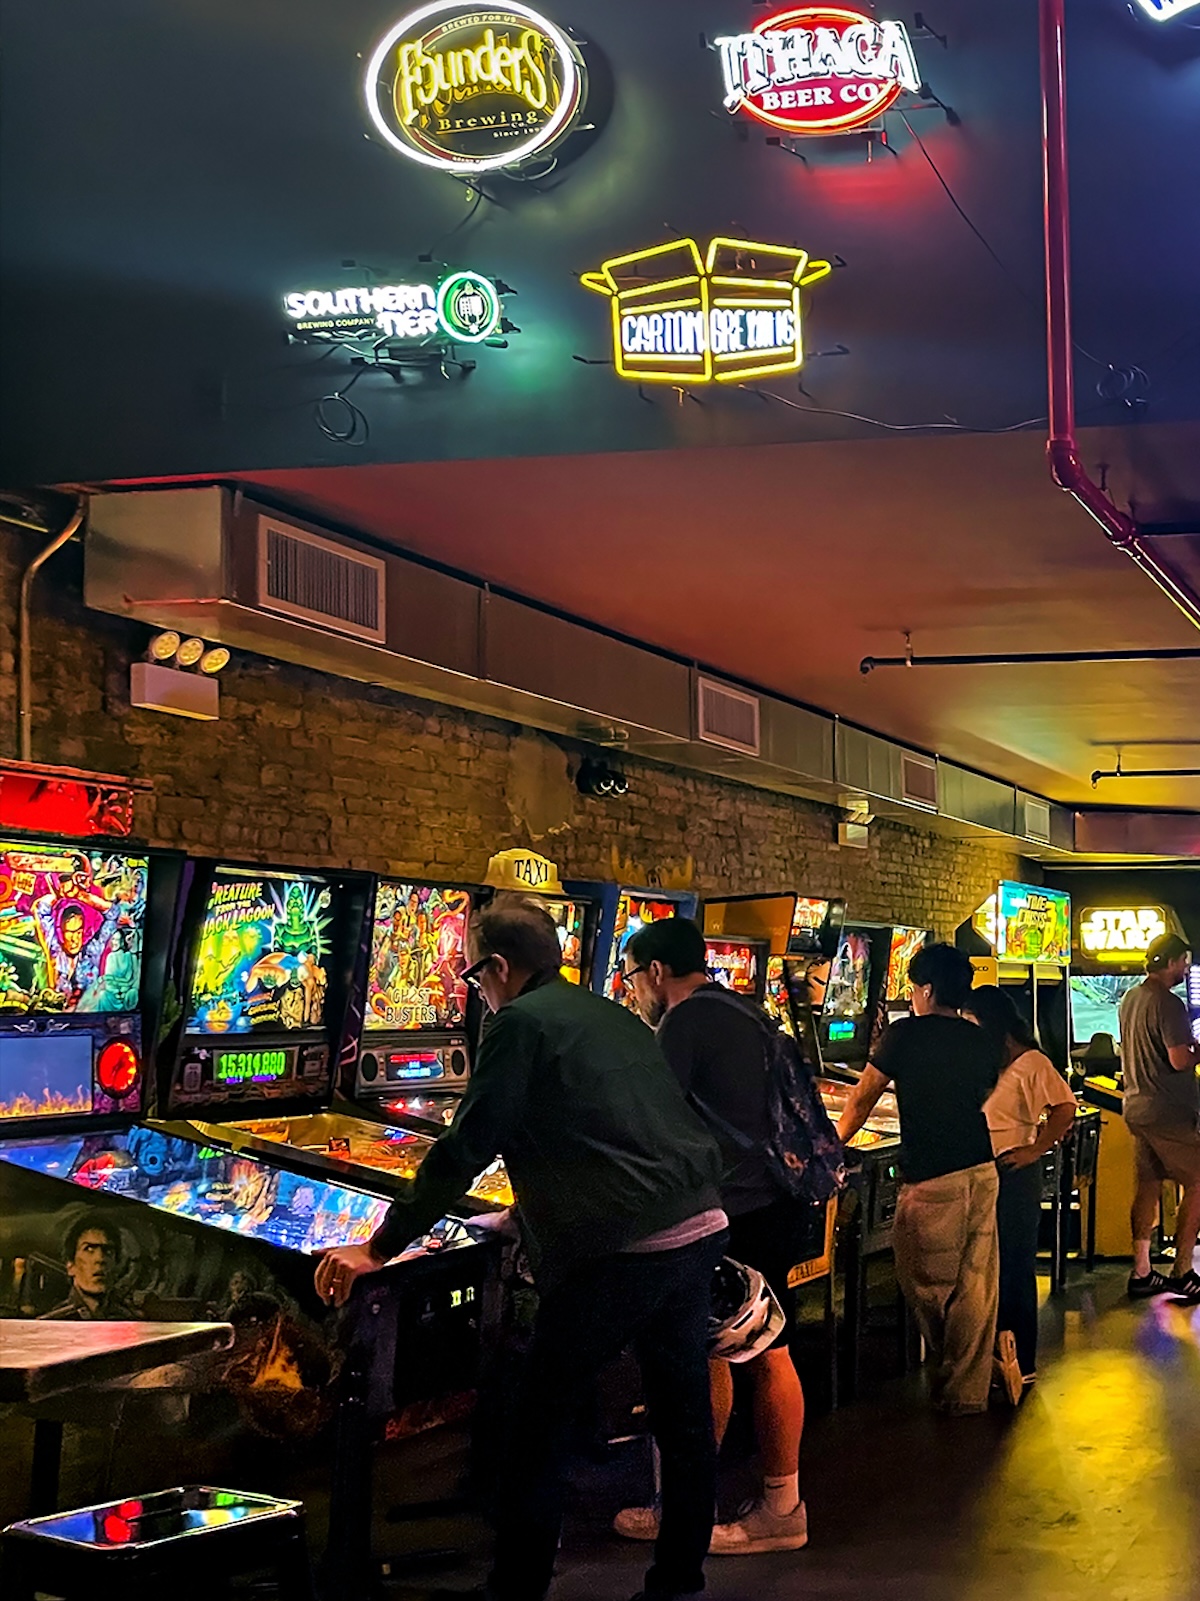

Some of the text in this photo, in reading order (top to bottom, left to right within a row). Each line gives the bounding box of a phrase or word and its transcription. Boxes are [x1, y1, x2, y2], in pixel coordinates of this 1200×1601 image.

[441, 14, 517, 33] BREWED FOR US
[399, 28, 548, 126] Founders
[714, 20, 922, 115] ITHACA
[761, 86, 834, 112] BEER
[438, 109, 538, 131] Brewing
[492, 129, 520, 139] Since
[284, 283, 437, 319] SOUTHERN
[296, 317, 375, 331] BREWING COMPANY
[375, 308, 438, 338] TIER
[621, 310, 706, 354] CARTON
[514, 858, 548, 886] TAXI
[1026, 893, 1048, 911] TIME
[230, 903, 276, 930] LAGOON
[1081, 909, 1165, 931] STAR
[384, 1004, 438, 1024] BUSTERS
